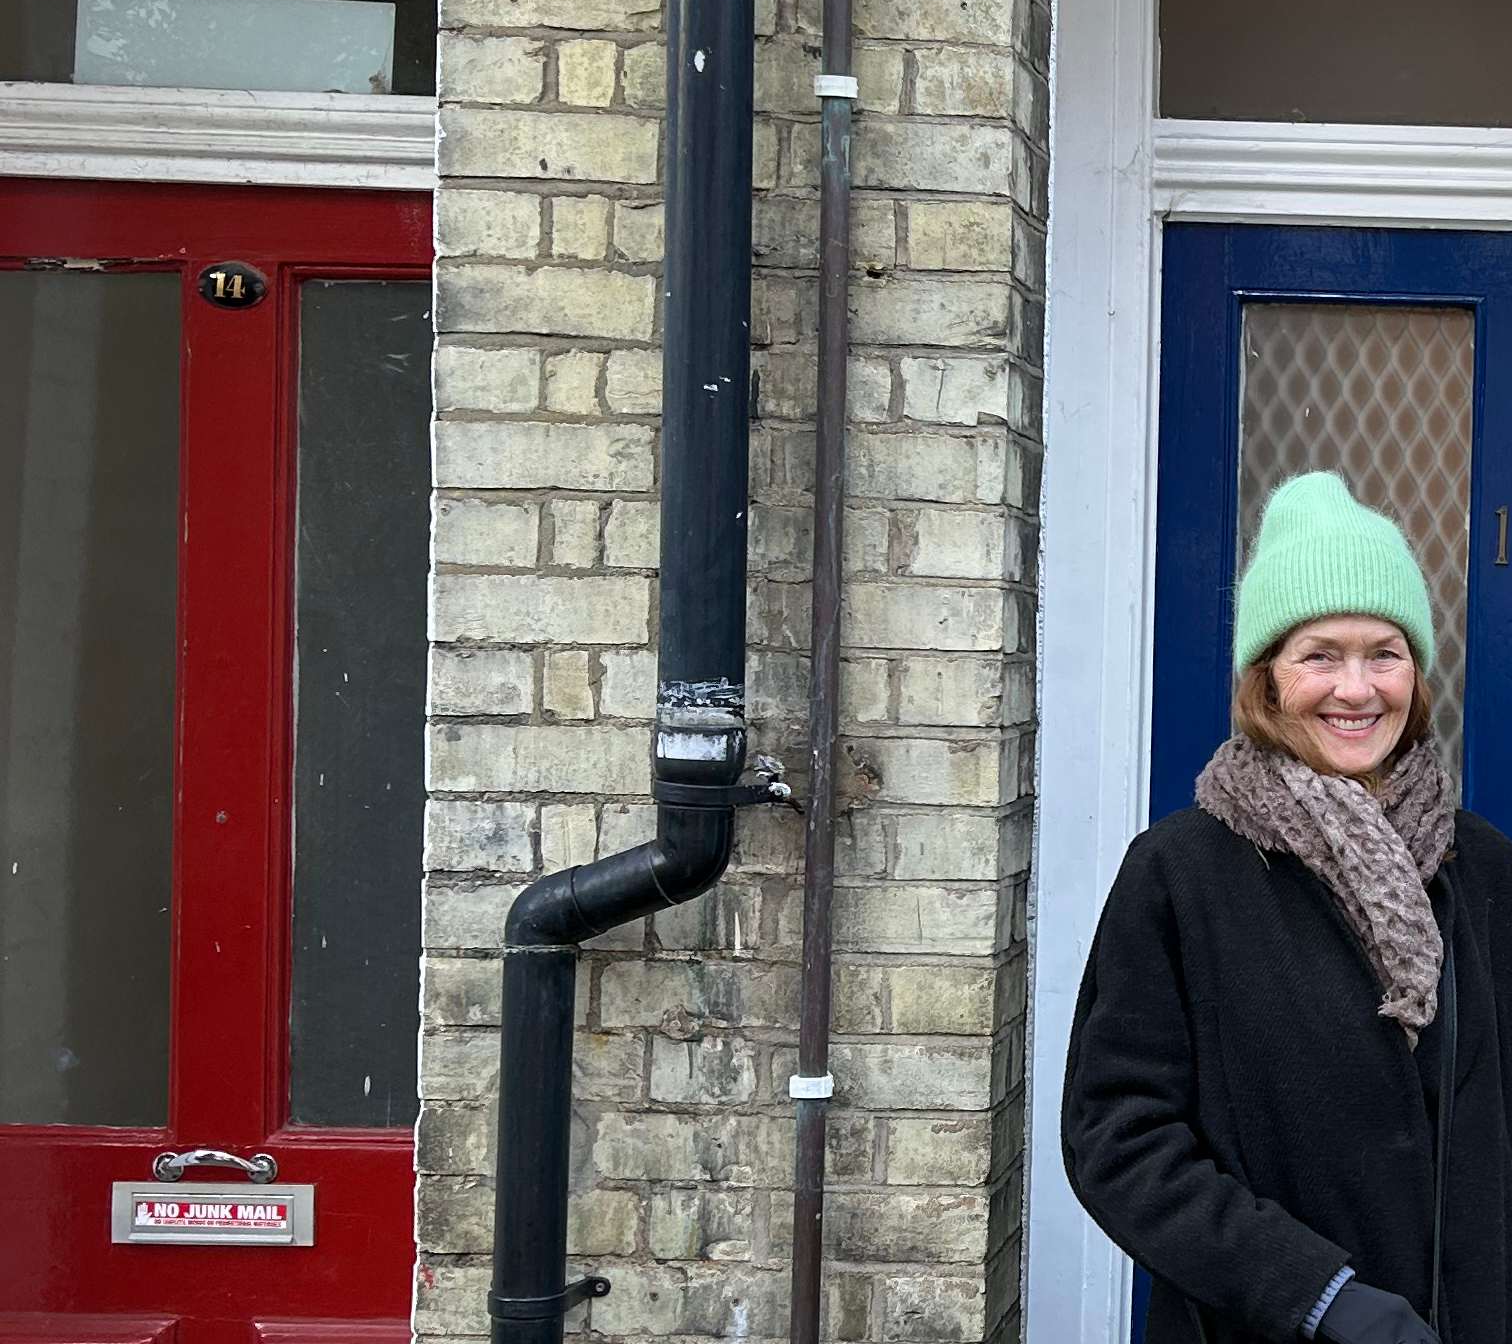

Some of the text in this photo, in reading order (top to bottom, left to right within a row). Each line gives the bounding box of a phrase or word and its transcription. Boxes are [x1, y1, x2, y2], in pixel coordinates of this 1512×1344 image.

[209, 271, 246, 299] 14
[154, 1203, 282, 1220] NO JUNK MAIL
